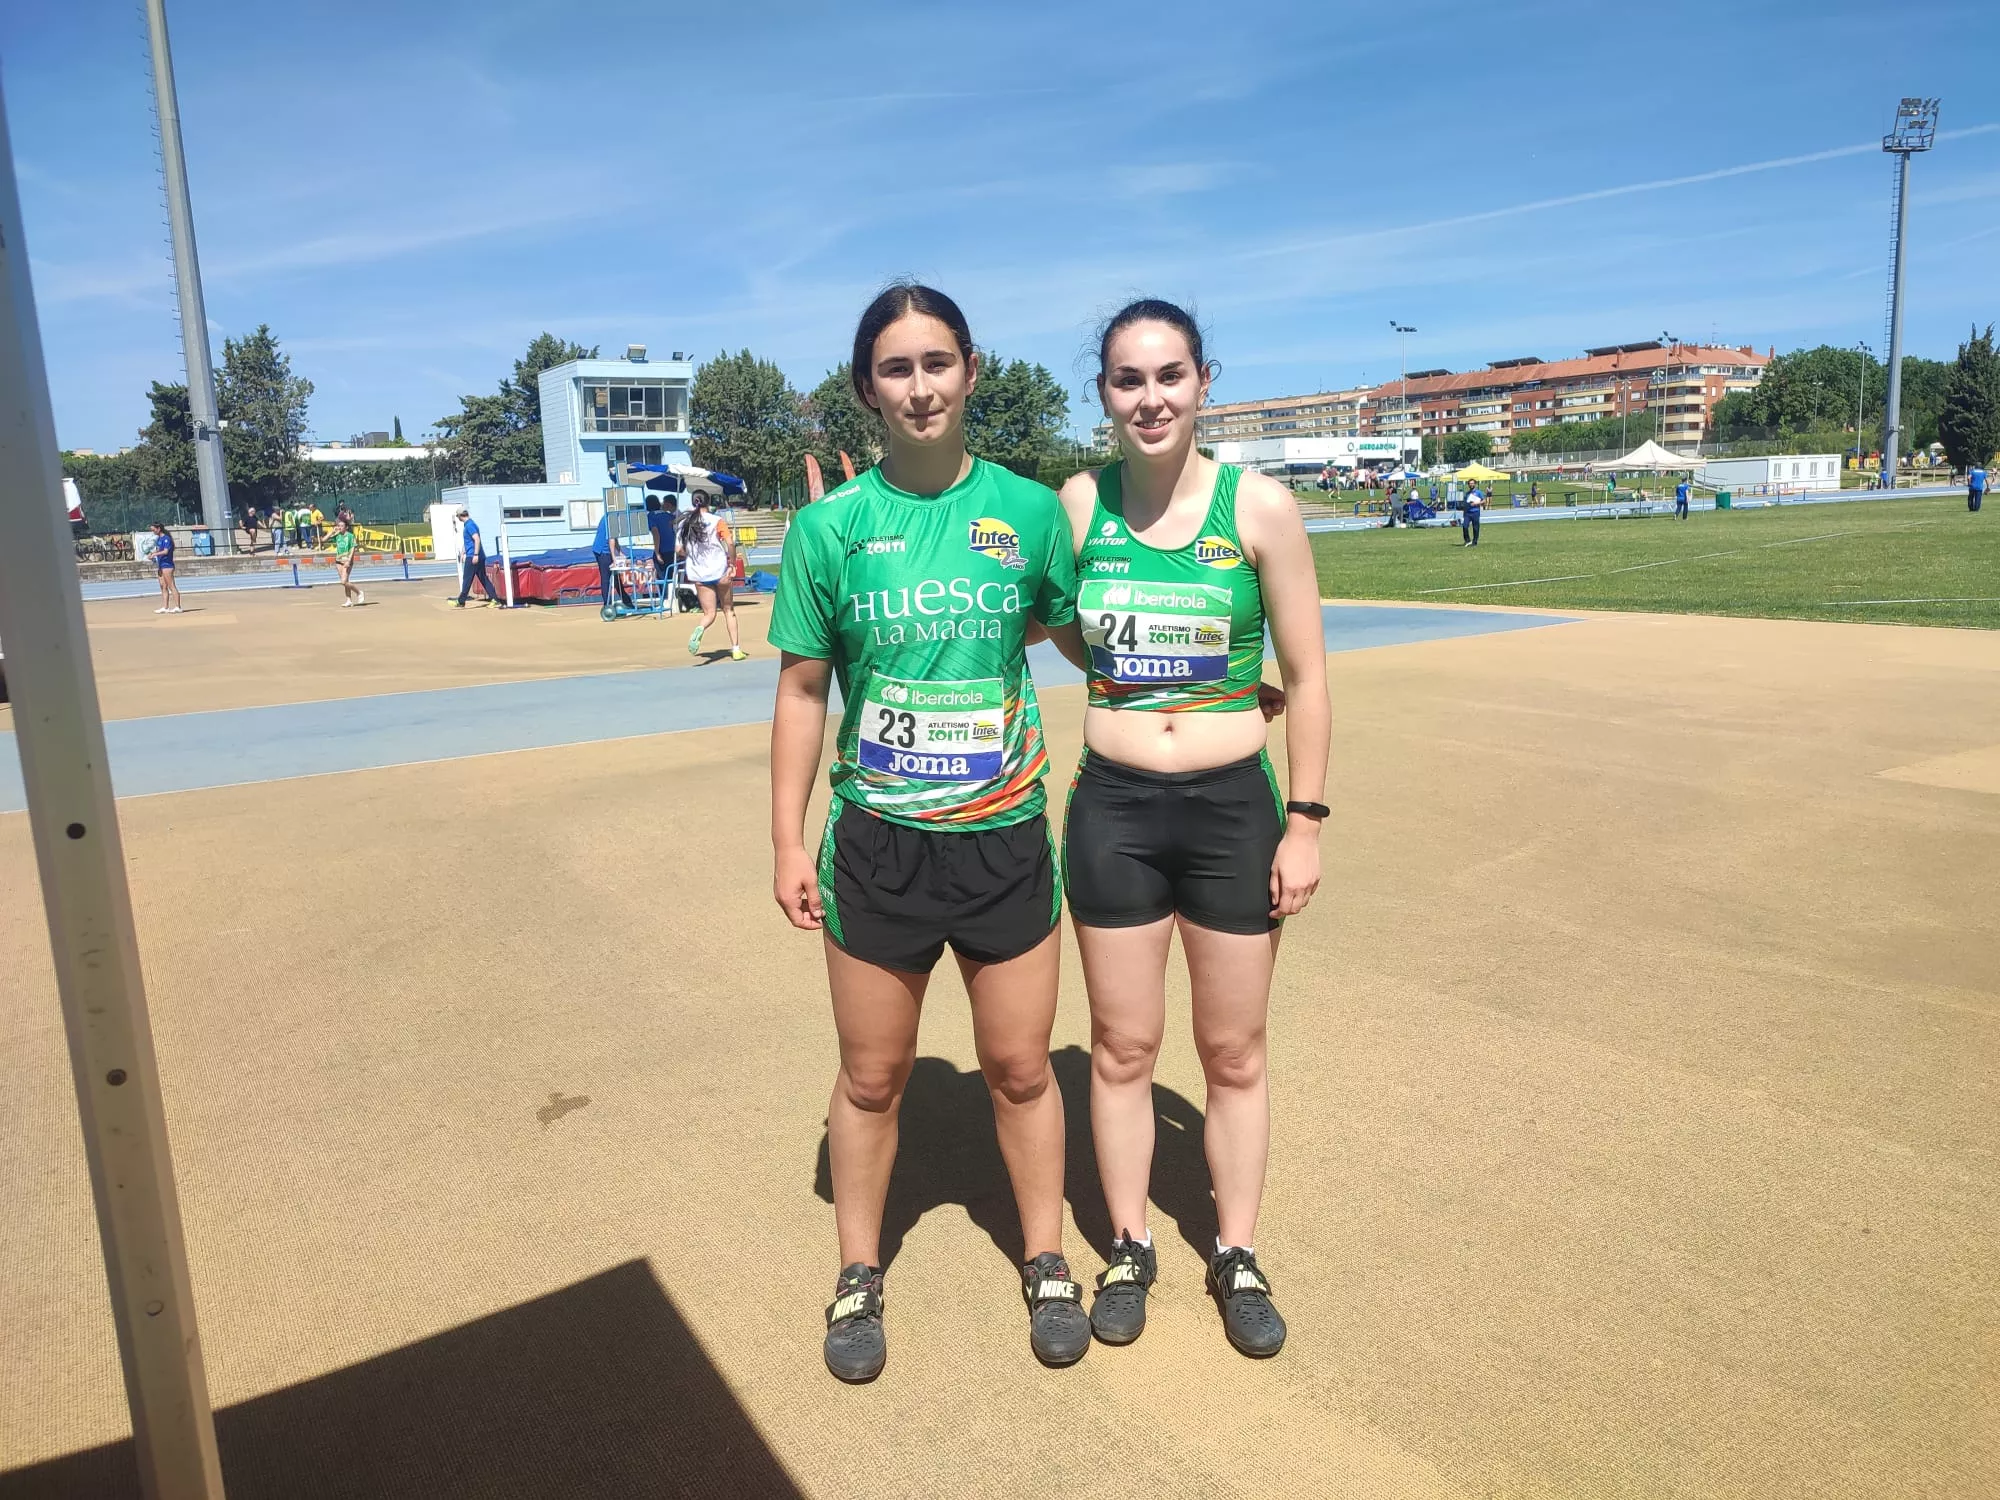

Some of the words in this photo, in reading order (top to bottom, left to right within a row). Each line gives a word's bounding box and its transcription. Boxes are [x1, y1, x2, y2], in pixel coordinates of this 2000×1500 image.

[867, 534, 904, 542] ATLETISMO
[1088, 537, 1128, 546] VIATOR
[866, 541, 905, 555] ZOITI
[1091, 561, 1131, 574] ZOITI
[1133, 590, 1207, 609] Iberdrola
[1099, 613, 1138, 652] 24
[1148, 624, 1191, 633] ATLETISMO
[1148, 632, 1190, 644] ZOITI
[911, 690, 983, 705] Iberdrola
[878, 708, 916, 749] 23
[927, 729, 969, 742] ZOITI
[1038, 1280, 1075, 1298] NIKE
[831, 1291, 868, 1322] NIKE
